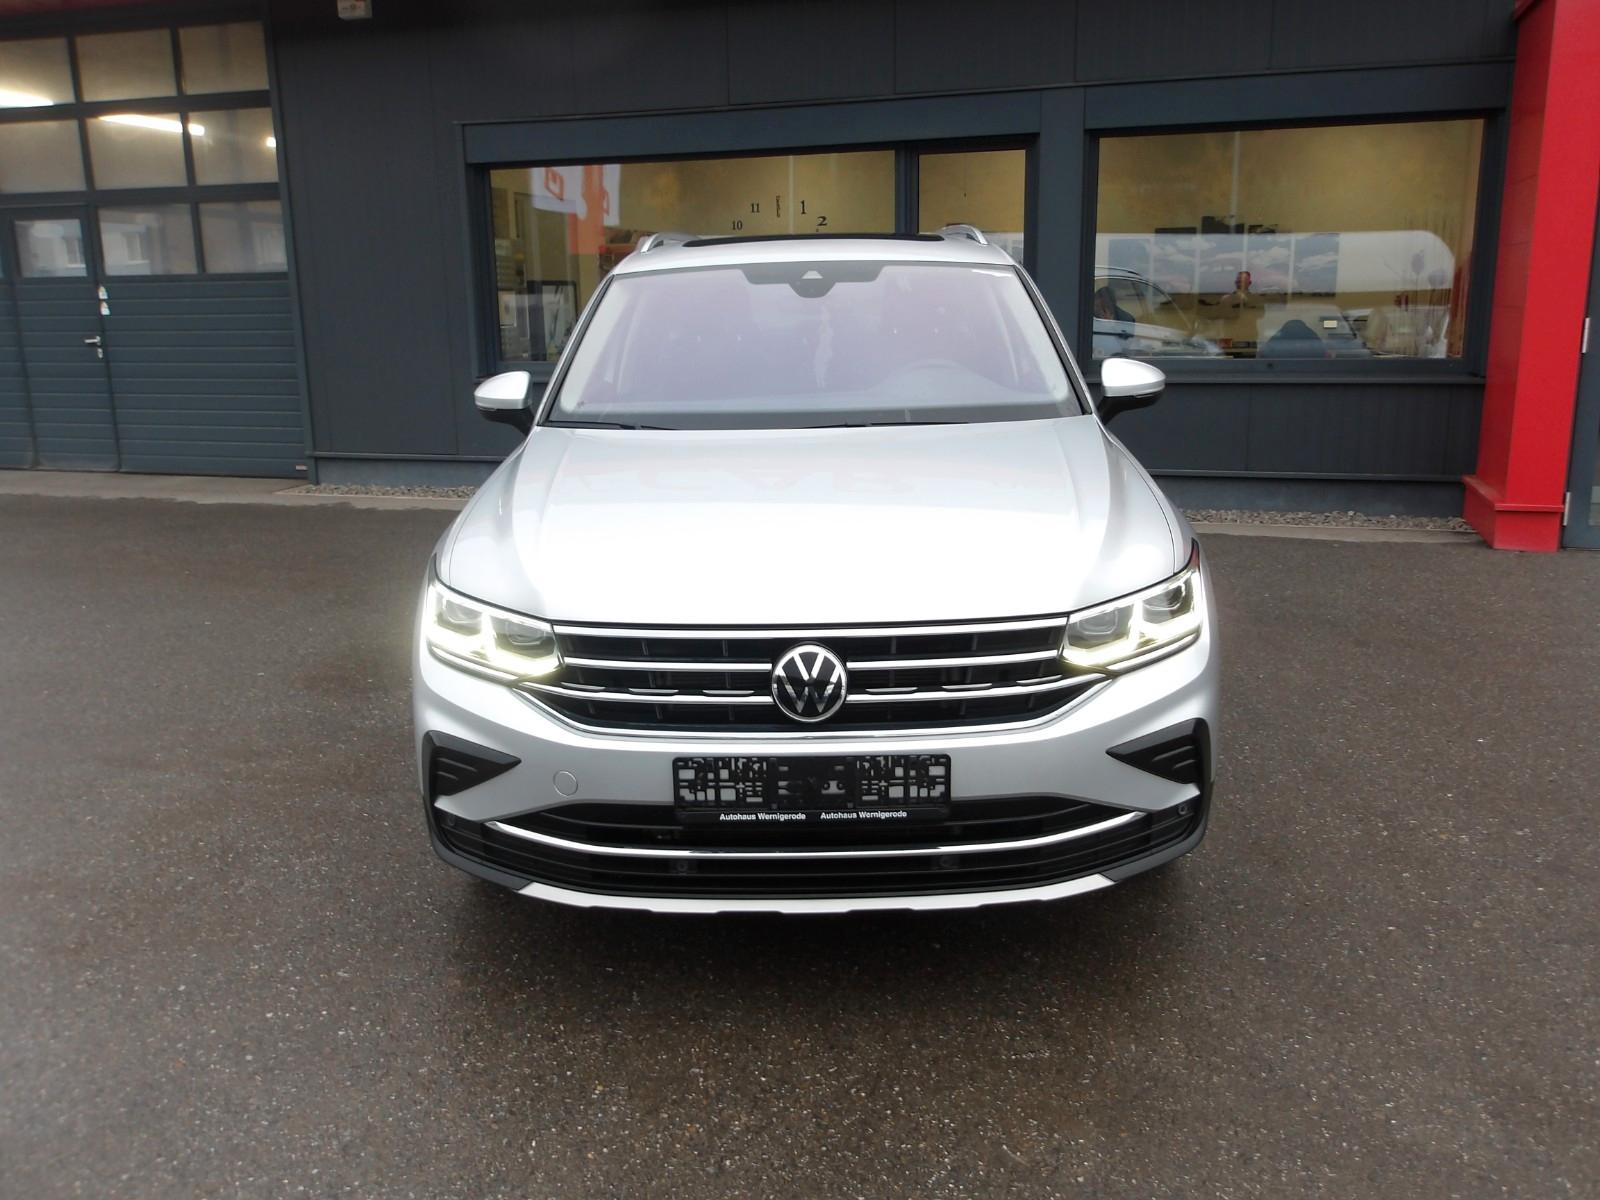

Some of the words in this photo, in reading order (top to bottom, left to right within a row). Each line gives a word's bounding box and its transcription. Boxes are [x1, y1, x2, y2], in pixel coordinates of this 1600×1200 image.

[751, 203, 760, 213] 11
[800, 200, 807, 215] 1
[731, 220, 743, 231] 10
[816, 216, 827, 226] 2
[719, 813, 757, 821] Autohaus
[757, 812, 806, 821] Wernigerode
[820, 811, 857, 819] Autohaus
[858, 810, 908, 819] Wernigerode
